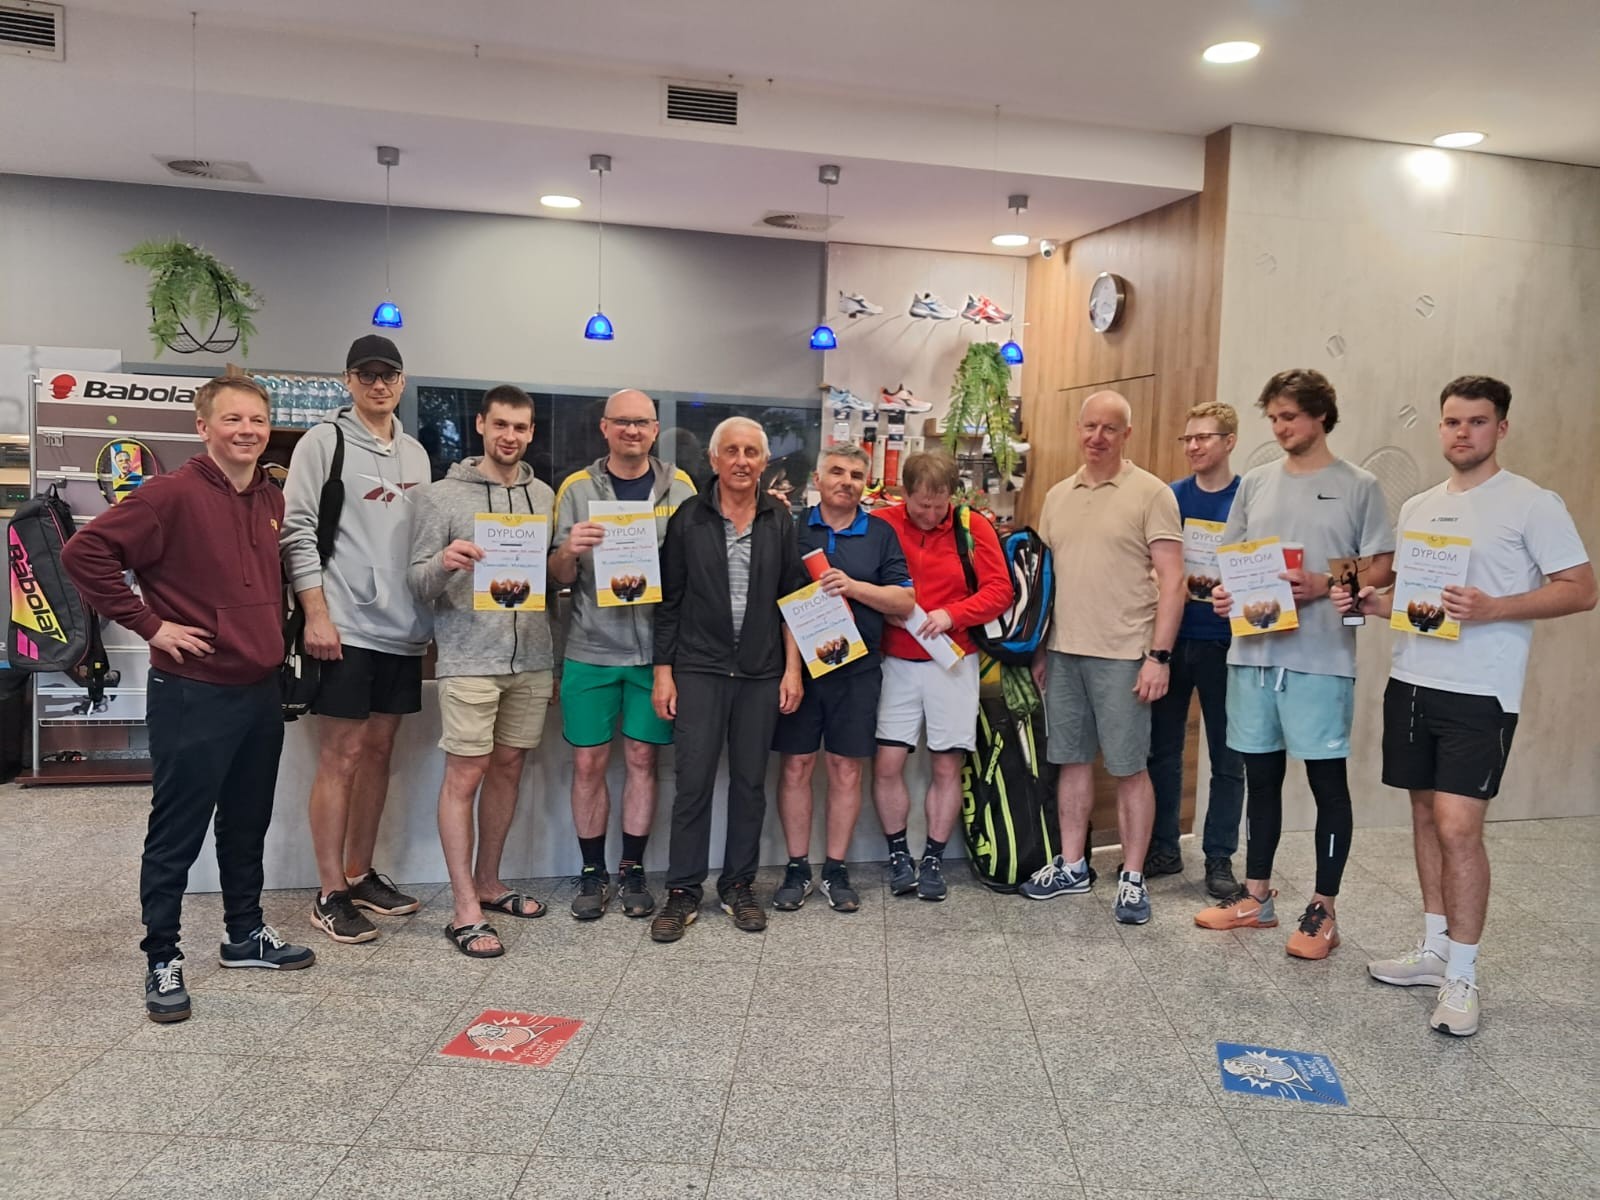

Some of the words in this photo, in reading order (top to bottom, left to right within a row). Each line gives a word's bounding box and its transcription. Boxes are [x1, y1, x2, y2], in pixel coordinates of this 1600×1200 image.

[83, 380, 202, 403] Babola
[488, 528, 535, 539] DYPLOM
[1192, 531, 1223, 543] DYPLO
[1229, 552, 1273, 567] DYPLOM
[1412, 547, 1457, 562] DYPLOM
